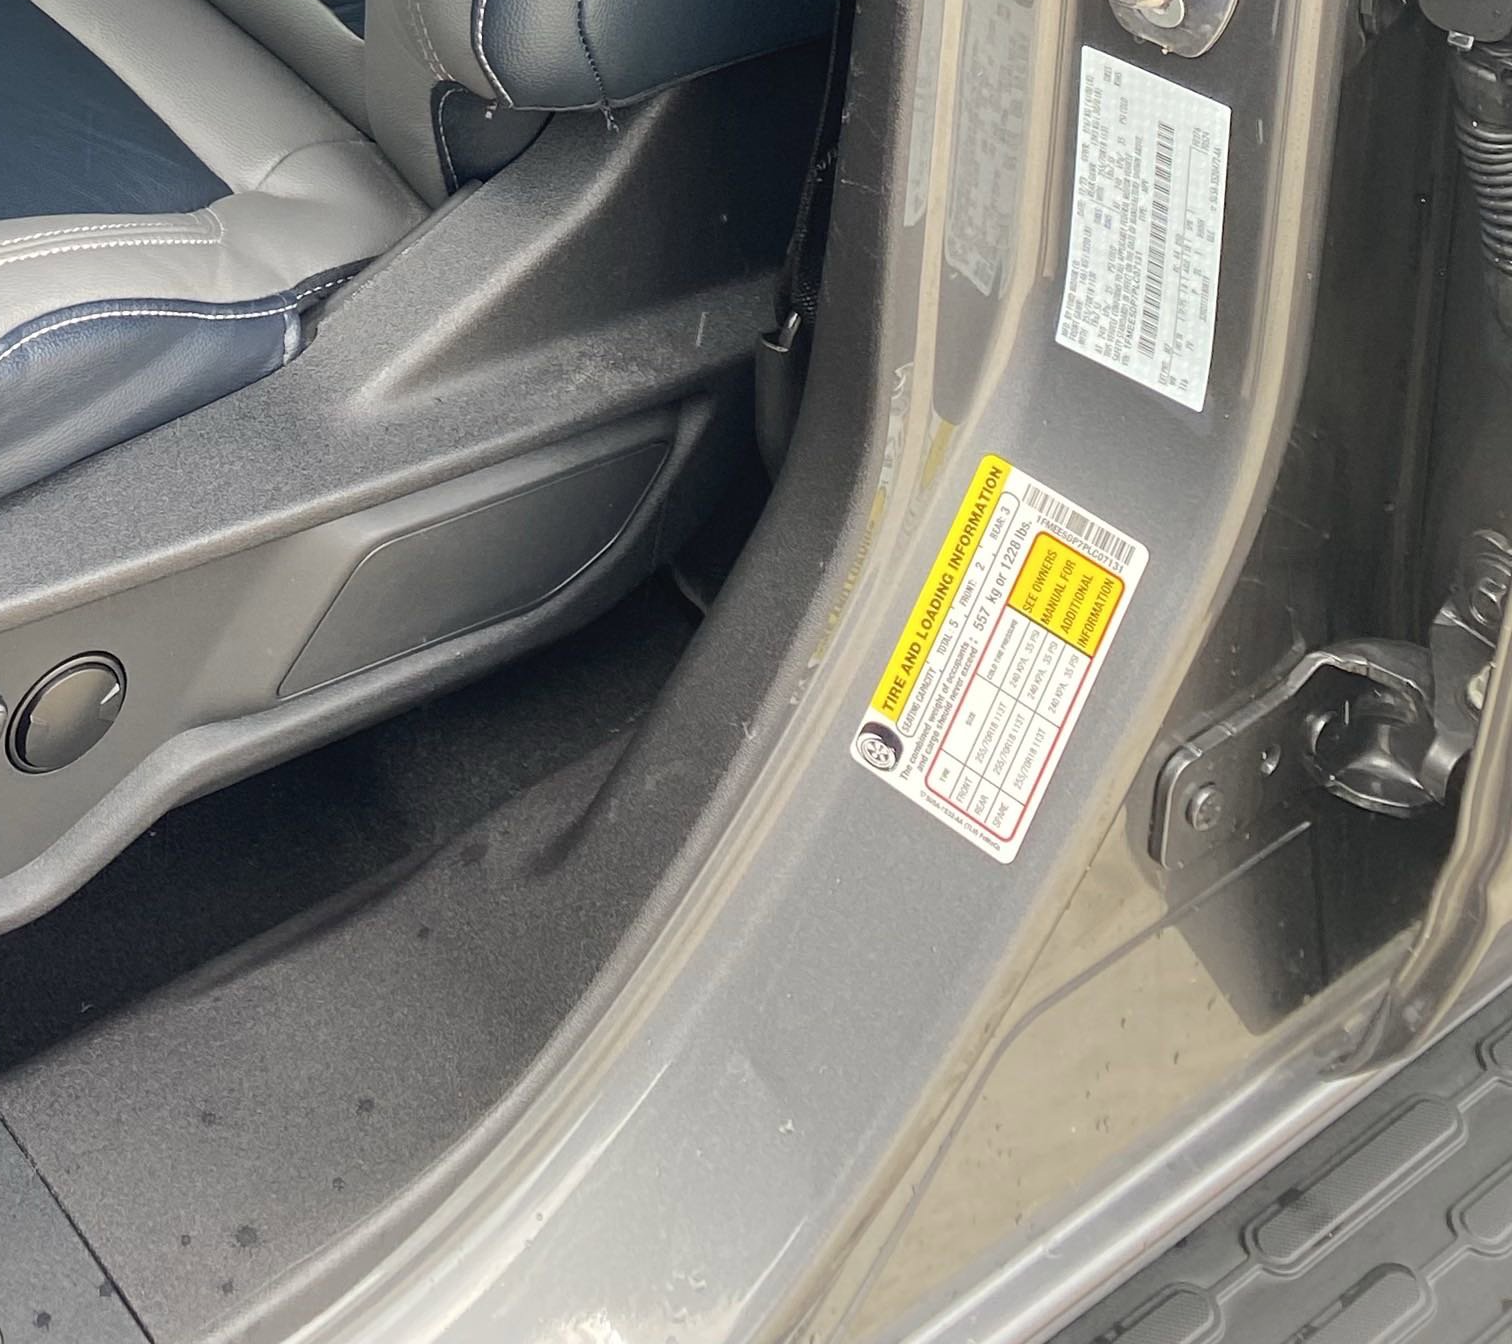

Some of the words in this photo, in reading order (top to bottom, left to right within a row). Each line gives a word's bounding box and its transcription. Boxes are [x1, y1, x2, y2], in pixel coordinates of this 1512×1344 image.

[1000, 504, 1011, 516] 3
[1013, 516, 1032, 541] lbs.
[974, 560, 985, 571] 2
[999, 538, 1021, 571] 1228
[881, 674, 907, 715] TIRE
[898, 638, 923, 676] AND
[915, 570, 955, 640] LOADING
[946, 464, 1003, 571] INFORMATION
[994, 570, 1008, 587] or
[1021, 591, 1038, 614] SEE
[1031, 547, 1059, 593] OWNERS
[1039, 580, 1067, 626] MANUAL
[1059, 557, 1077, 582] FOR
[985, 585, 1002, 605] kg
[1058, 571, 1094, 634] ADDITIONAL
[948, 618, 958, 628] 5
[971, 604, 992, 632] 557
[1075, 576, 1115, 649] INFORMATION
[899, 762, 913, 781] The
[907, 721, 932, 765] combined
[926, 693, 947, 724] weight
[940, 681, 950, 694] of
[945, 639, 971, 685] occupants
[900, 700, 921, 733] SEATING
[914, 665, 937, 703] CAPACITY
[915, 753, 928, 772] and
[923, 729, 942, 757] cargo
[934, 700, 953, 730] should
[948, 676, 964, 701] never
[959, 645, 978, 677] exceed
[955, 775, 973, 804] FRONT
[973, 792, 989, 817] REAR
[991, 801, 1010, 829] SPARE
